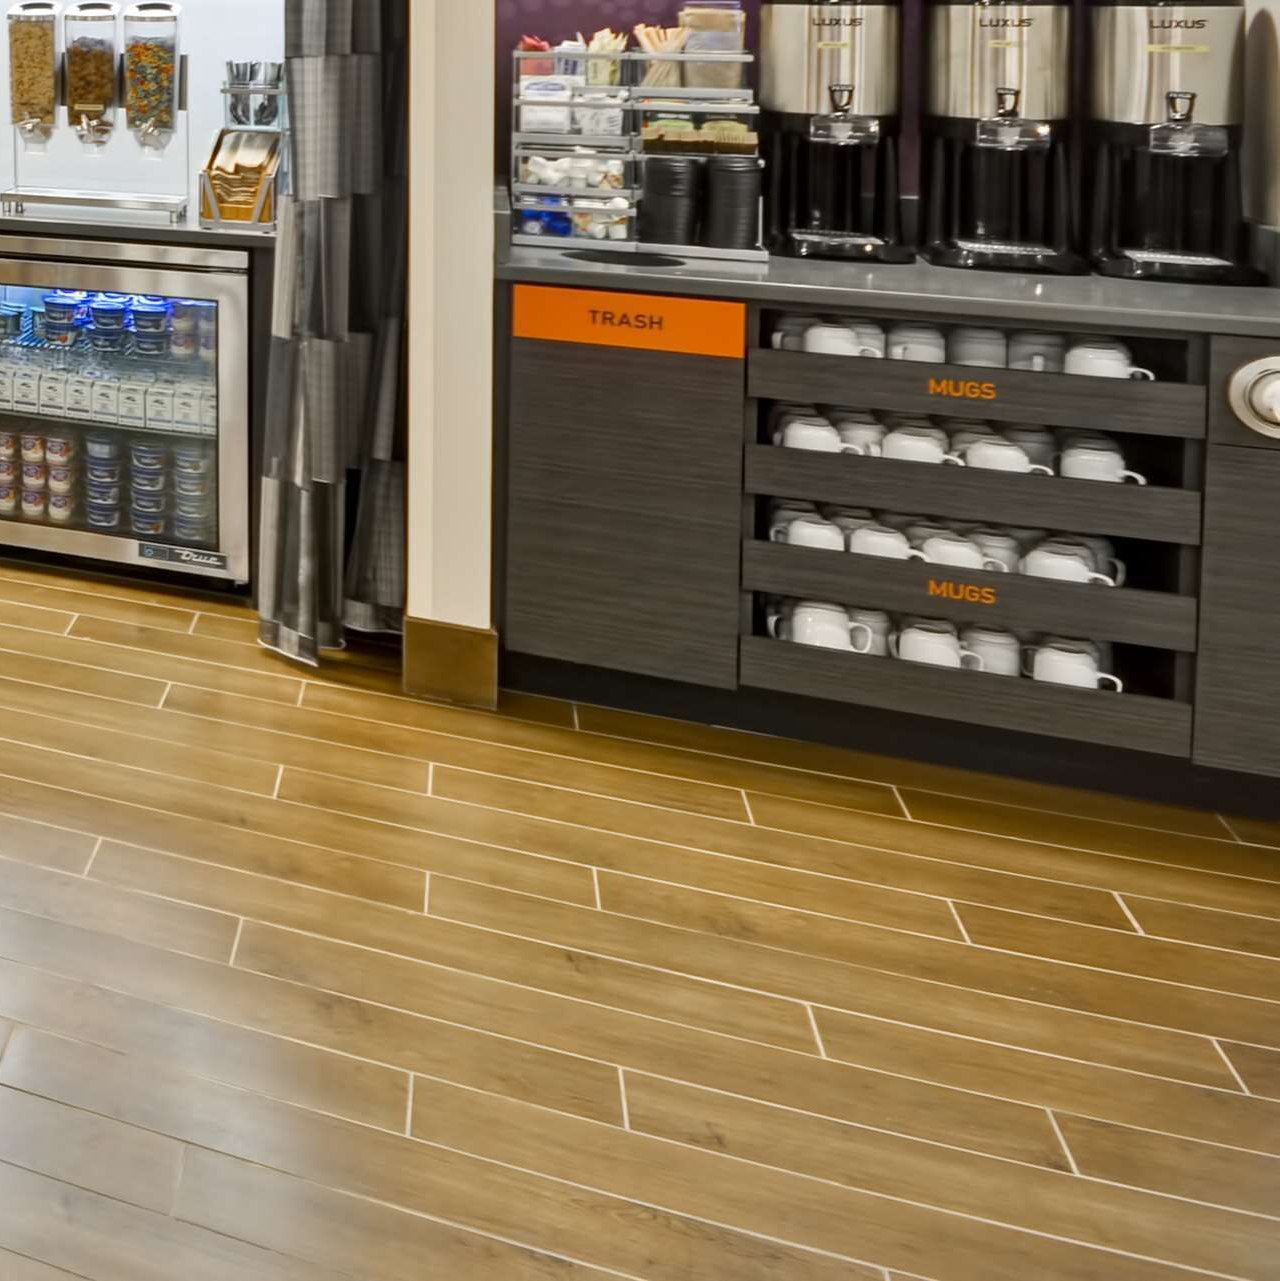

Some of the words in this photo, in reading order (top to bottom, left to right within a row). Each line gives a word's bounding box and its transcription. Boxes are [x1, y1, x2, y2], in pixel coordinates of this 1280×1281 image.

[812, 17, 863, 27] LUXUS
[979, 17, 1034, 28] LUXUS
[1149, 19, 1209, 29] LUXUS
[587, 309, 664, 331] TRASH
[928, 377, 997, 400] MUGS
[928, 579, 996, 604] MUGS
